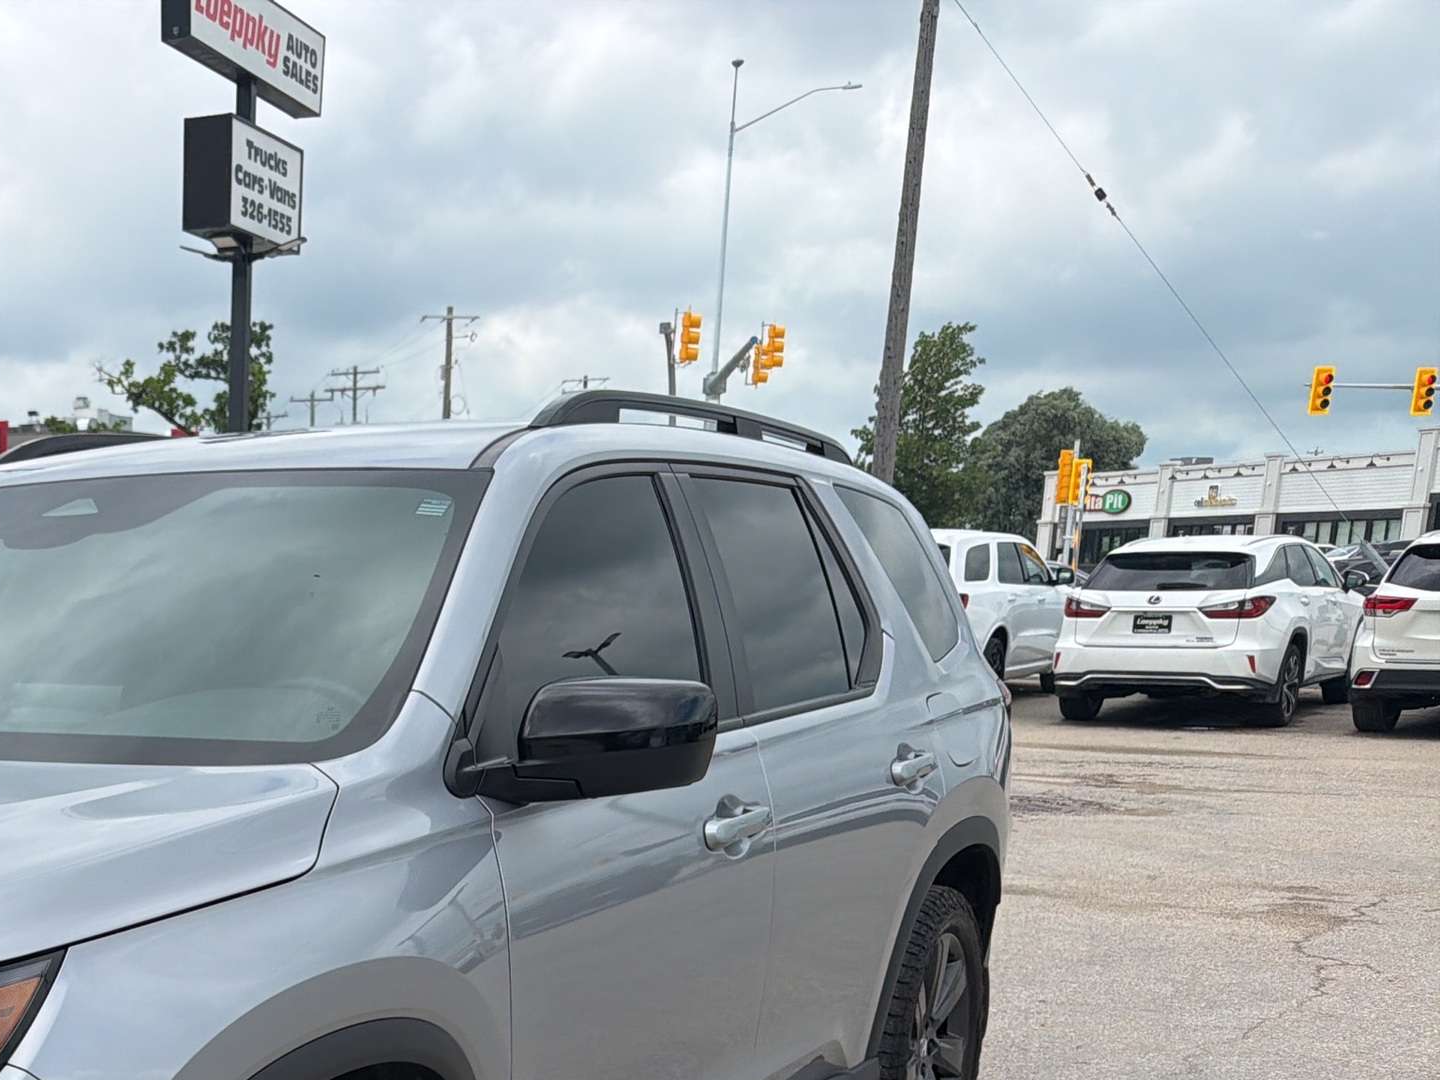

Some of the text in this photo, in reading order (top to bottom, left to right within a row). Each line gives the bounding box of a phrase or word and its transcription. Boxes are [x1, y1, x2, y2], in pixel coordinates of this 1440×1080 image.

[286, 33, 317, 69] AUTO
[282, 55, 318, 94] SALES
[246, 138, 288, 178] Trucks
[241, 195, 292, 236] 326-1555
[1105, 494, 1123, 509] Pit
